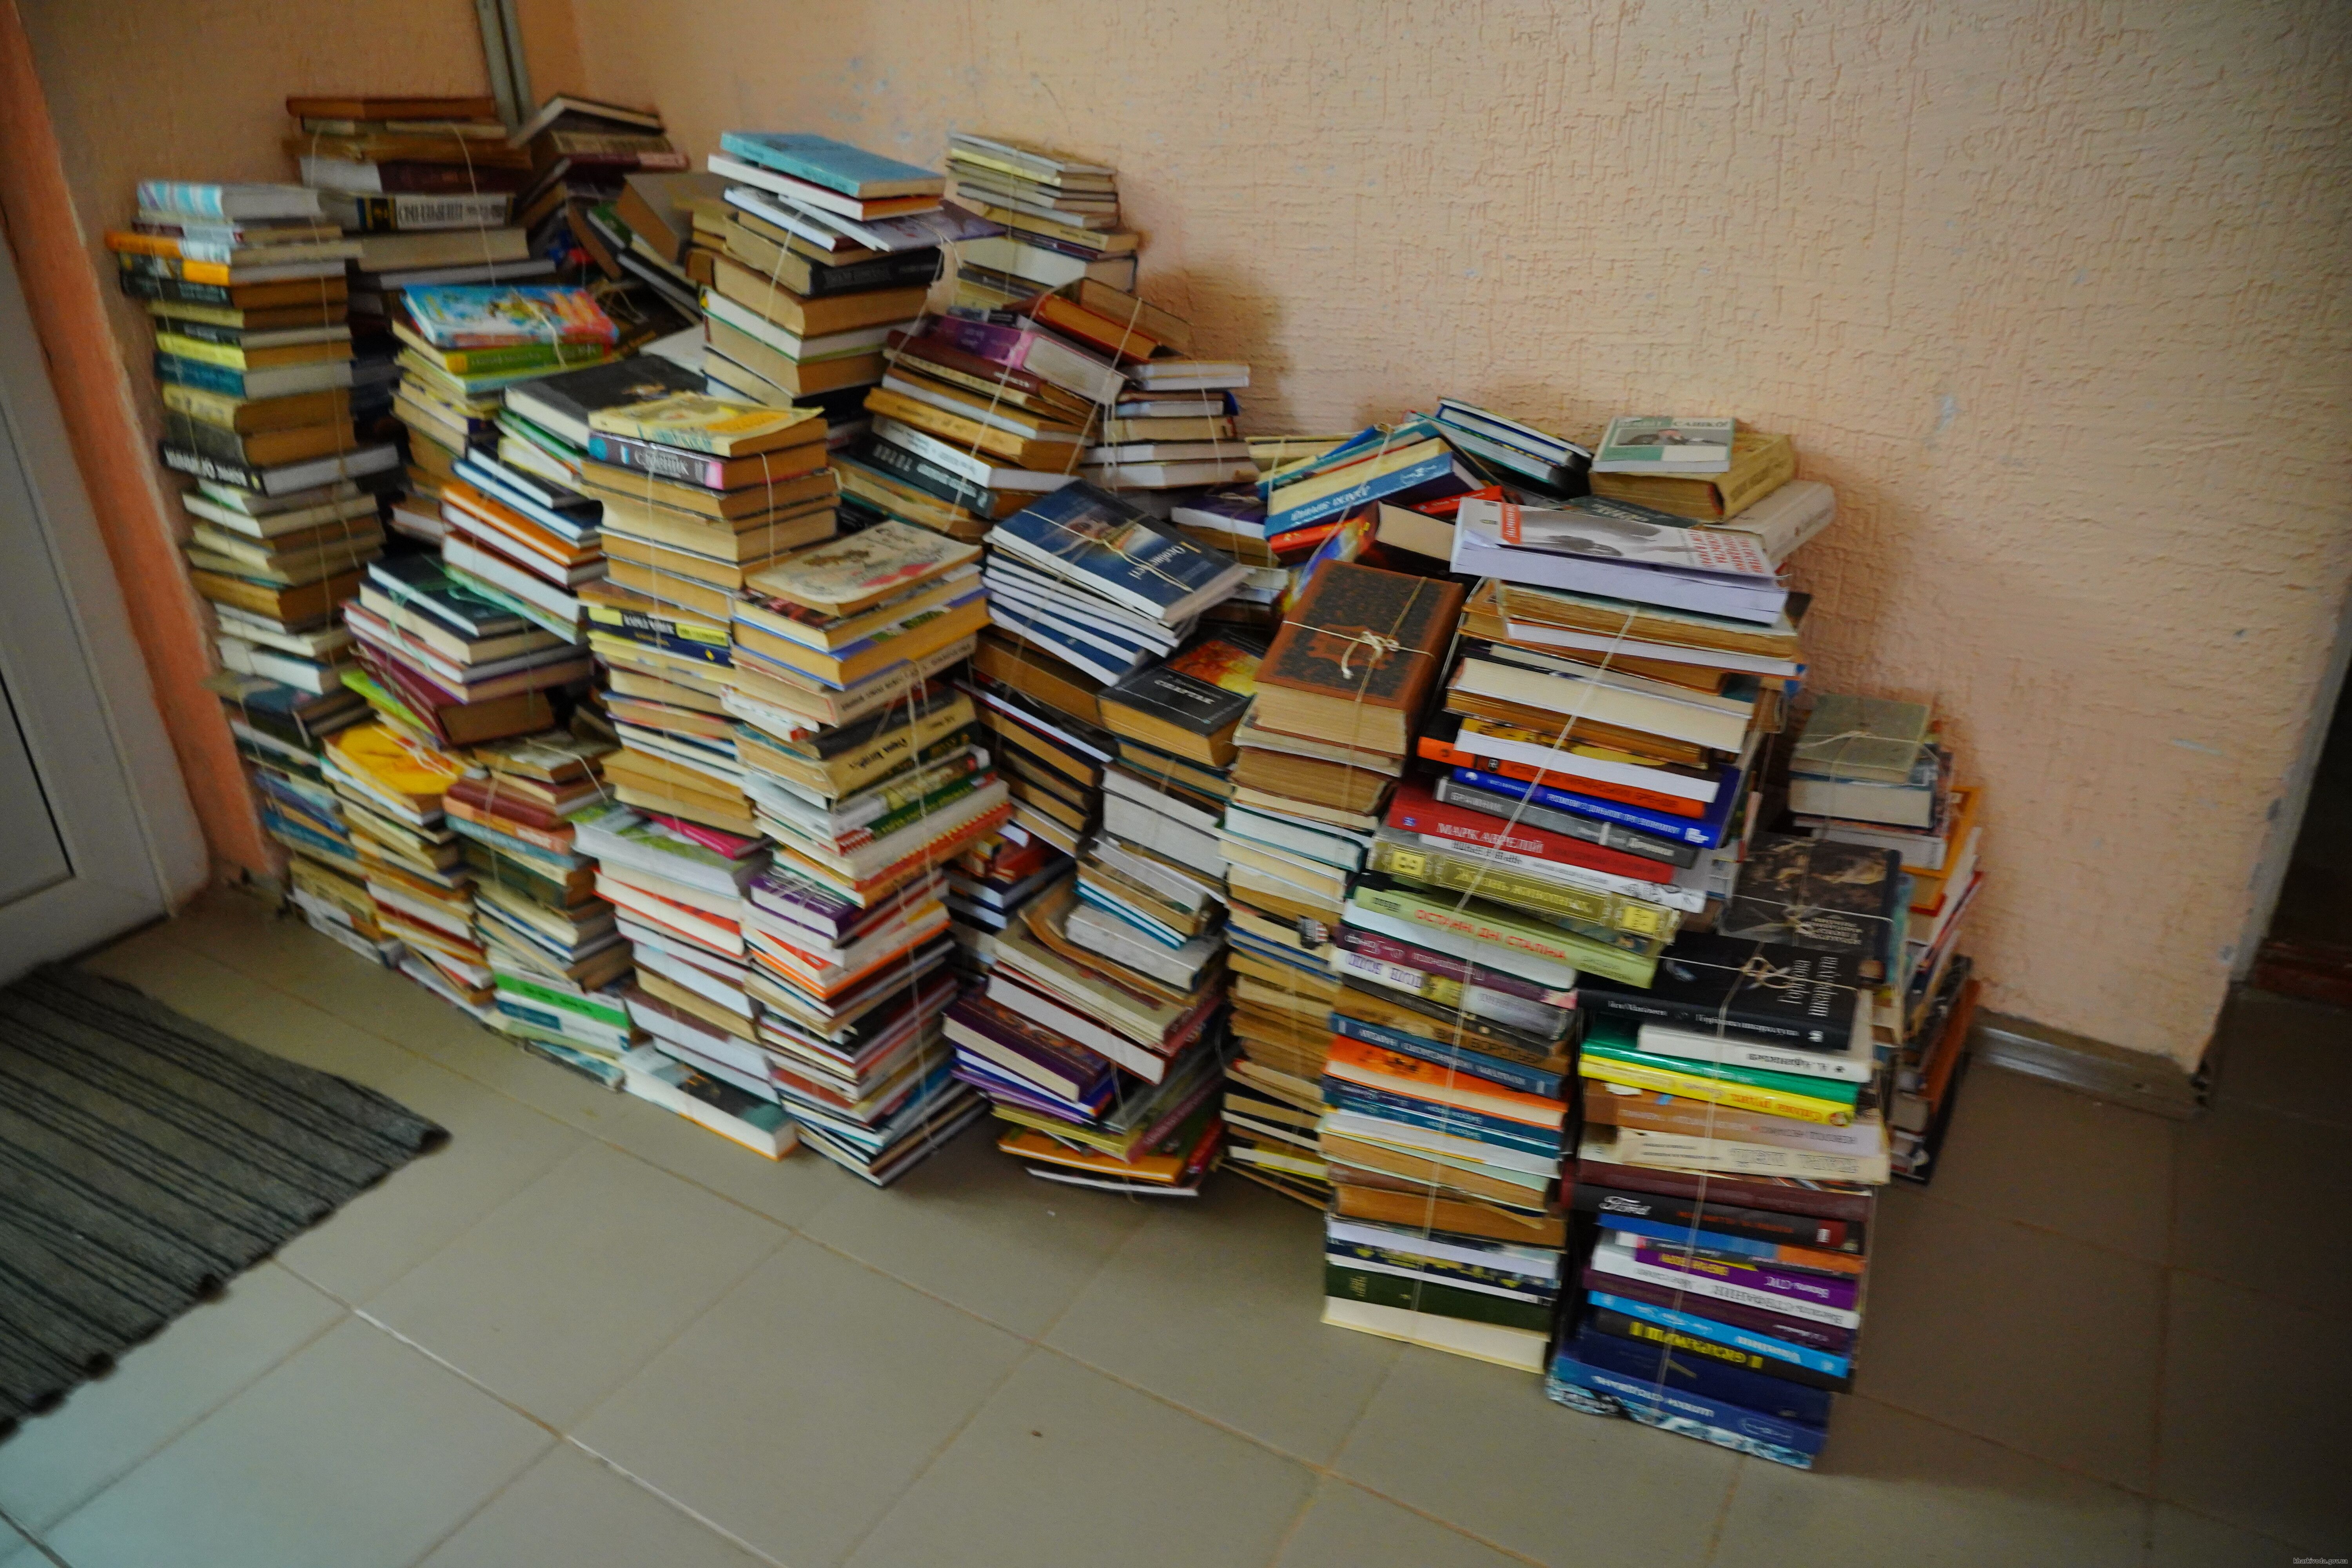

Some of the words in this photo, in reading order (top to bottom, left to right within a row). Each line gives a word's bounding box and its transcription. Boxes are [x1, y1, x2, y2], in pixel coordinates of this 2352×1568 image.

[1129, 545, 1186, 581] Особиссті
[1436, 822, 1482, 842] МАРК
[1479, 831, 1544, 854] АВРЕЛІЙ
[1415, 909, 1474, 934] ОСТАННІ
[1476, 927, 1504, 942] ДНІ
[1505, 935, 1568, 960] СТАЛІНА
[1777, 959, 1812, 1004] Горіова
[1599, 1195, 1652, 1216] Ford
